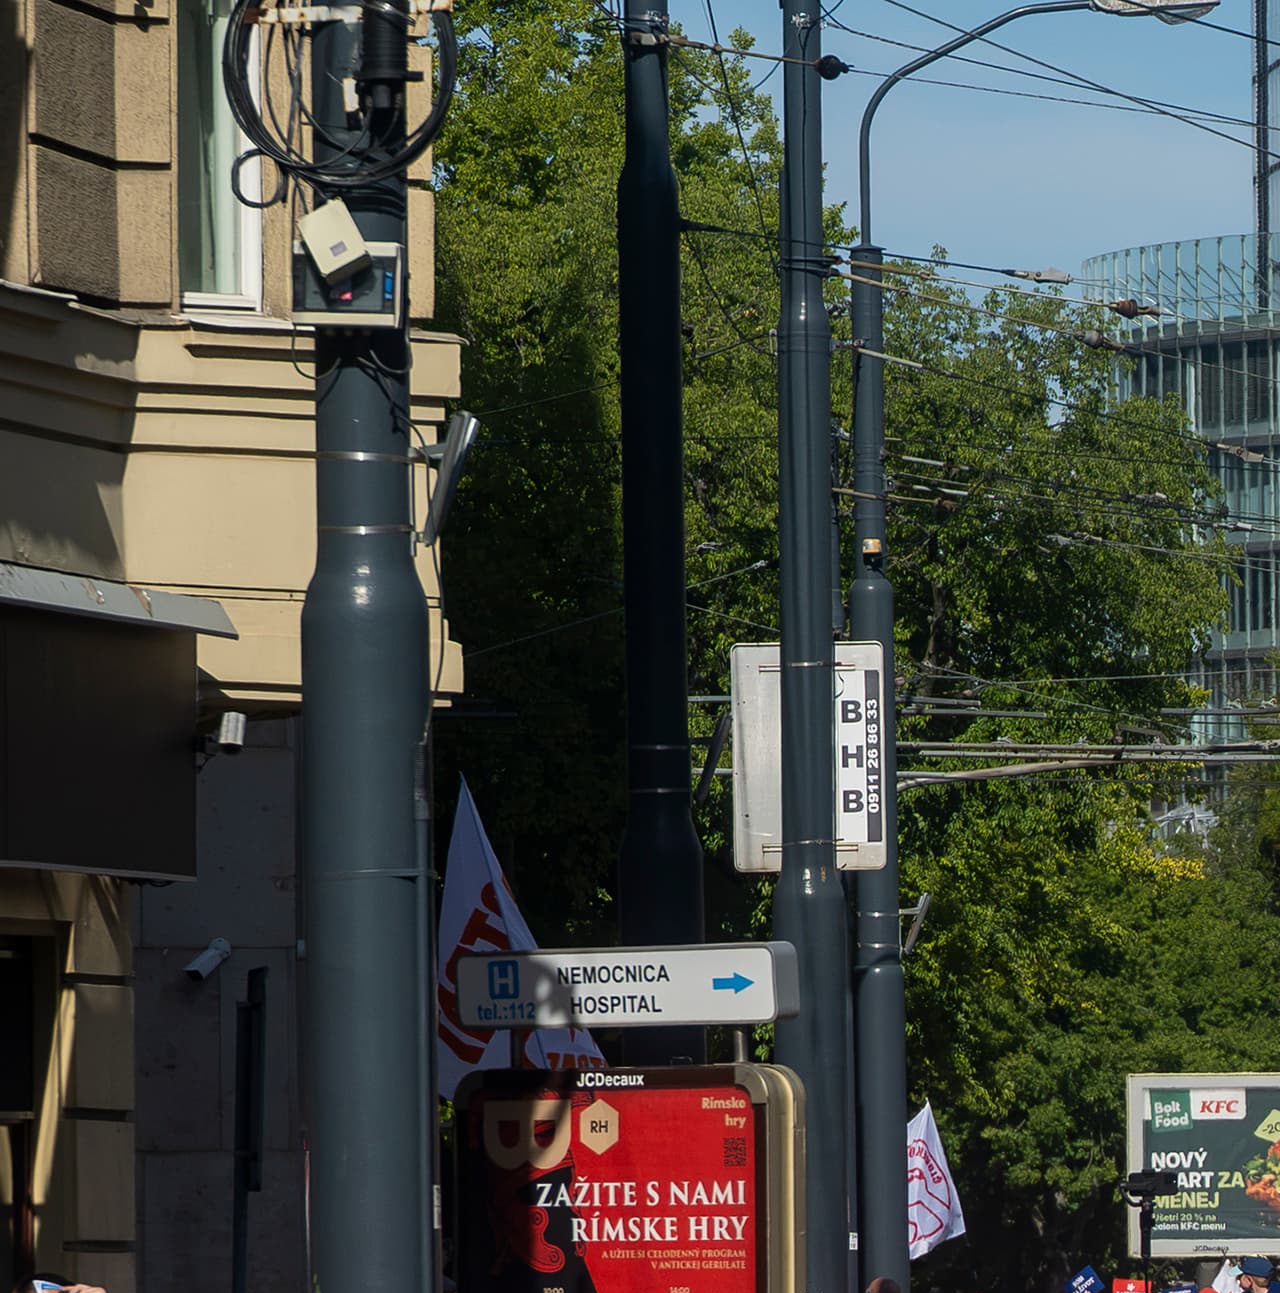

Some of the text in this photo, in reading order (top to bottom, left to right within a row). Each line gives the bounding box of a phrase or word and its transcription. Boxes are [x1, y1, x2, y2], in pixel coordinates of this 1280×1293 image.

[866, 698, 879, 813] 0911 26 86 33
[557, 965, 670, 984] NEMOCNICA
[477, 1002, 535, 1021] tel.:112
[570, 996, 662, 1014] HOSPITAL
[576, 1073, 644, 1087] JCDecaux
[1154, 1101, 1181, 1114] Bolt
[1200, 1100, 1239, 1113] KFC
[590, 1121, 608, 1133] RH
[725, 1115, 746, 1128] hry
[1155, 1112, 1189, 1128] Food
[1152, 1147, 1208, 1169] NOVÝ
[1218, 1172, 1245, 1188] ZA
[536, 1177, 745, 1208] ZAŽITE S NAMI
[1153, 1192, 1219, 1209] MENEJ
[571, 1211, 749, 1242] RÍMSKE HRY
[1180, 1223, 1200, 1231] KFC
[1201, 1223, 1226, 1231] menu
[701, 1249, 746, 1258] PROGRAM
